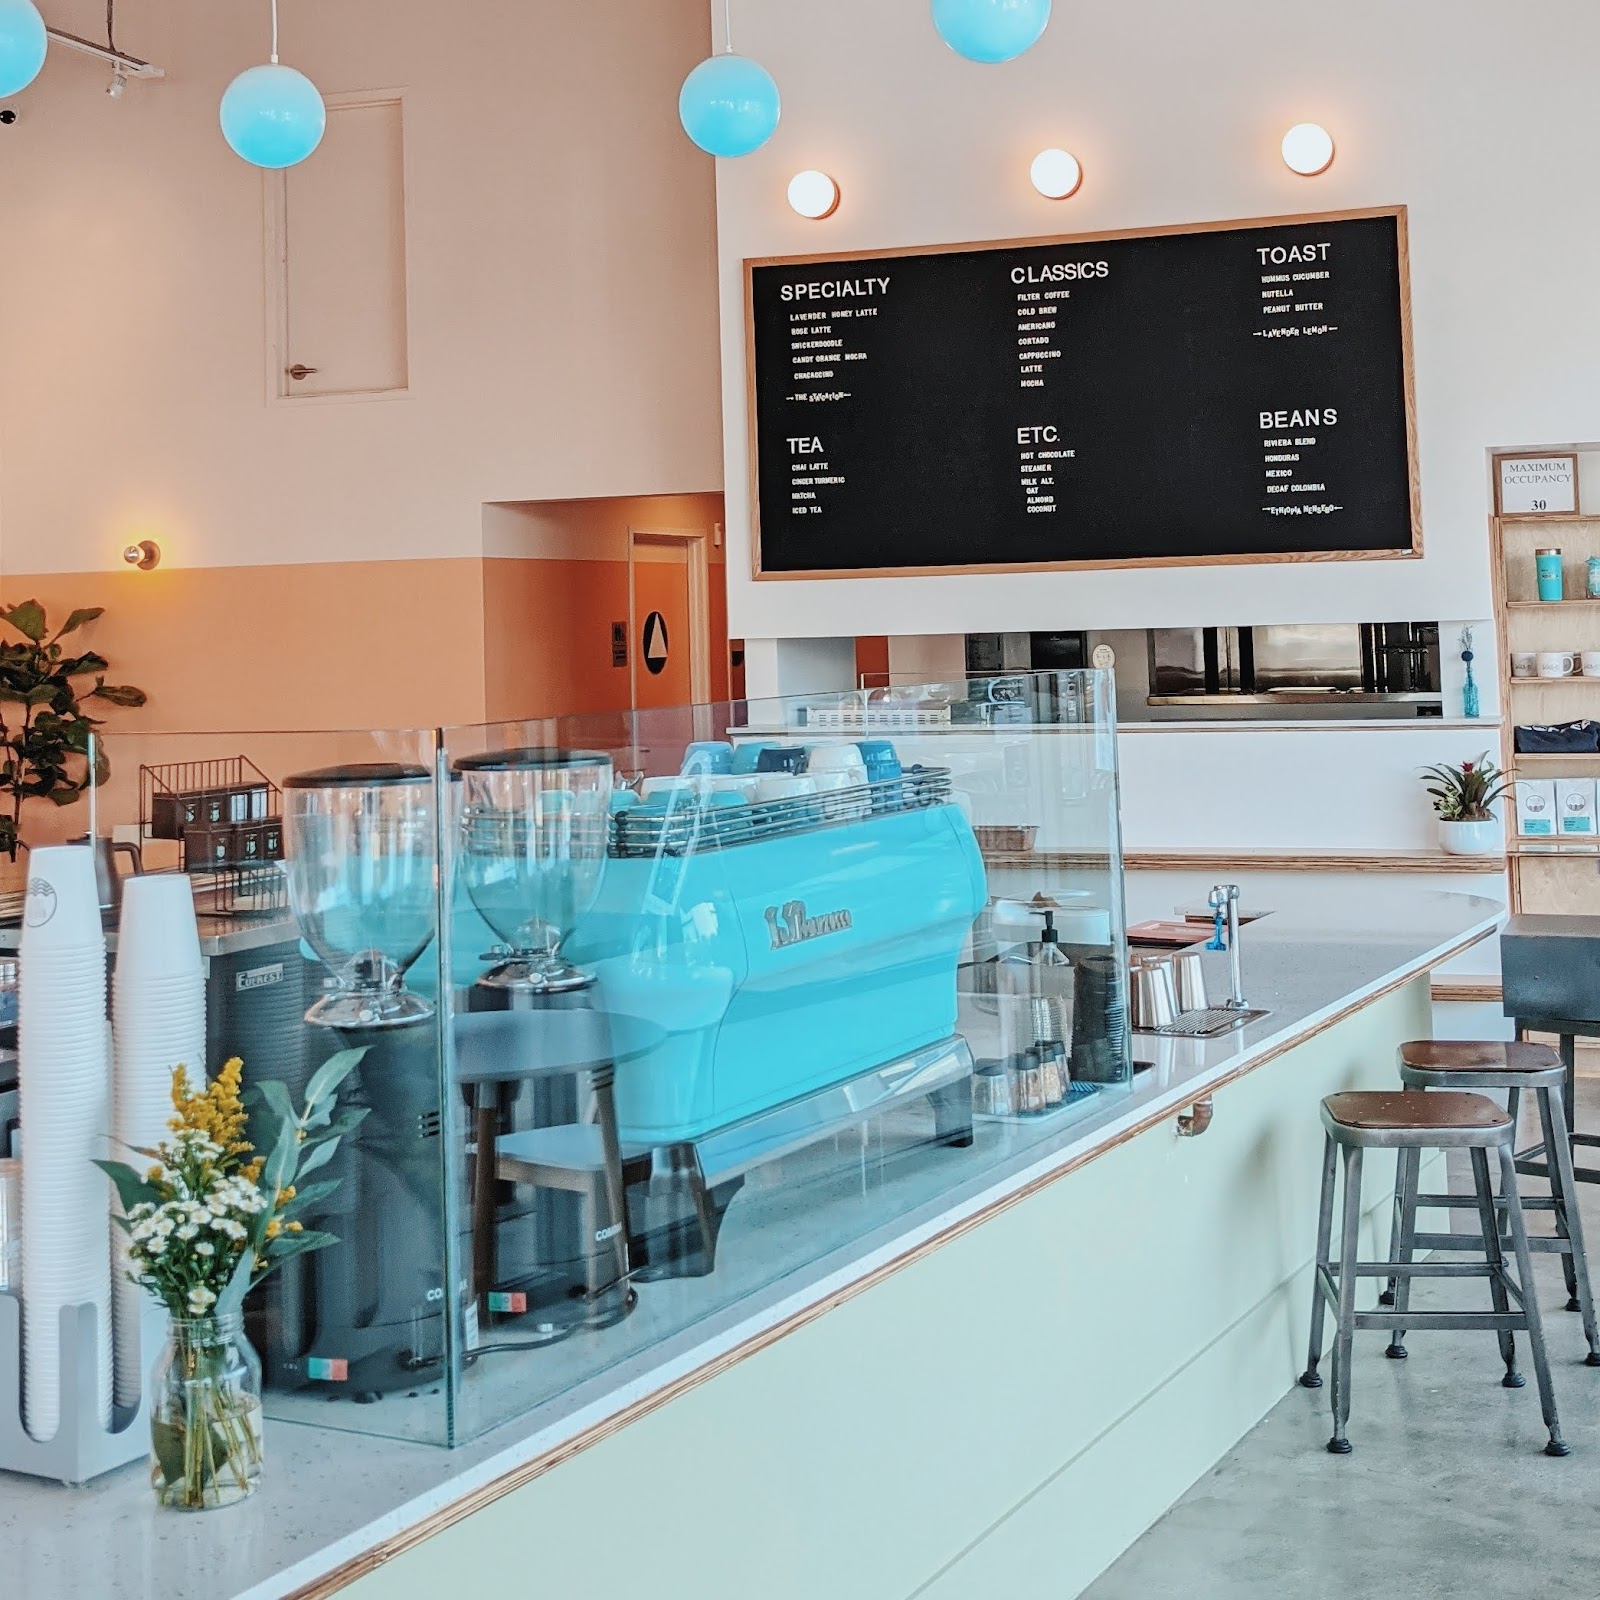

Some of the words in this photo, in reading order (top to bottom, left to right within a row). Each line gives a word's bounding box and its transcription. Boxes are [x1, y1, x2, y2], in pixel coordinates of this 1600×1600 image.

[1256, 243, 1331, 265] TOAST
[1010, 261, 1109, 284] CLASSICS
[1261, 274, 1290, 283] HUMMUS
[1292, 271, 1330, 281] CUCUMBER
[780, 277, 890, 301] SPECIALTY
[1262, 289, 1294, 298] NUTELLA
[1017, 293, 1040, 301] FILTER
[1044, 291, 1070, 299] COFFEE
[1017, 308, 1035, 316] COLD
[1039, 306, 1057, 314] BREW
[1263, 305, 1291, 314] PEANUT
[1295, 302, 1323, 311] BUTTER
[789, 312, 827, 321] LAVENDER
[831, 310, 853, 318] HONEY
[855, 308, 878, 317] LATTE
[791, 327, 808, 335] ROSE
[810, 326, 831, 334] LATTE
[1018, 321, 1056, 331] AMERICANO
[791, 339, 843, 350] SNICKERDOODLE
[1018, 337, 1049, 345] CORTADO
[792, 355, 814, 363] CANDY
[815, 354, 841, 362] ORANGE
[845, 352, 867, 361] MOCHA
[1019, 350, 1061, 360] CAPPUCCINO
[1020, 365, 1043, 373] LATTE
[1259, 408, 1338, 429] BEANS
[1017, 426, 1061, 444] ETC.
[786, 436, 824, 454] TEA
[1263, 438, 1292, 447] RIVIERA
[1295, 437, 1316, 446] BLEND
[1021, 452, 1034, 460] HOT
[1038, 450, 1075, 458] CHOCOLATE
[1264, 454, 1300, 462] HONDURAS
[809, 462, 829, 471] LATTE
[1021, 464, 1052, 473] STEAMER
[1509, 463, 1566, 473] MAXIMUM
[1266, 469, 1292, 478] MEXICO
[1504, 474, 1572, 484] OCCUPANCY
[1267, 485, 1289, 493] DECAF
[1291, 483, 1325, 492] COLOMBIA
[1027, 496, 1054, 504] ALMOND
[1027, 505, 1057, 513] COCONUT
[1531, 500, 1547, 511] 30
